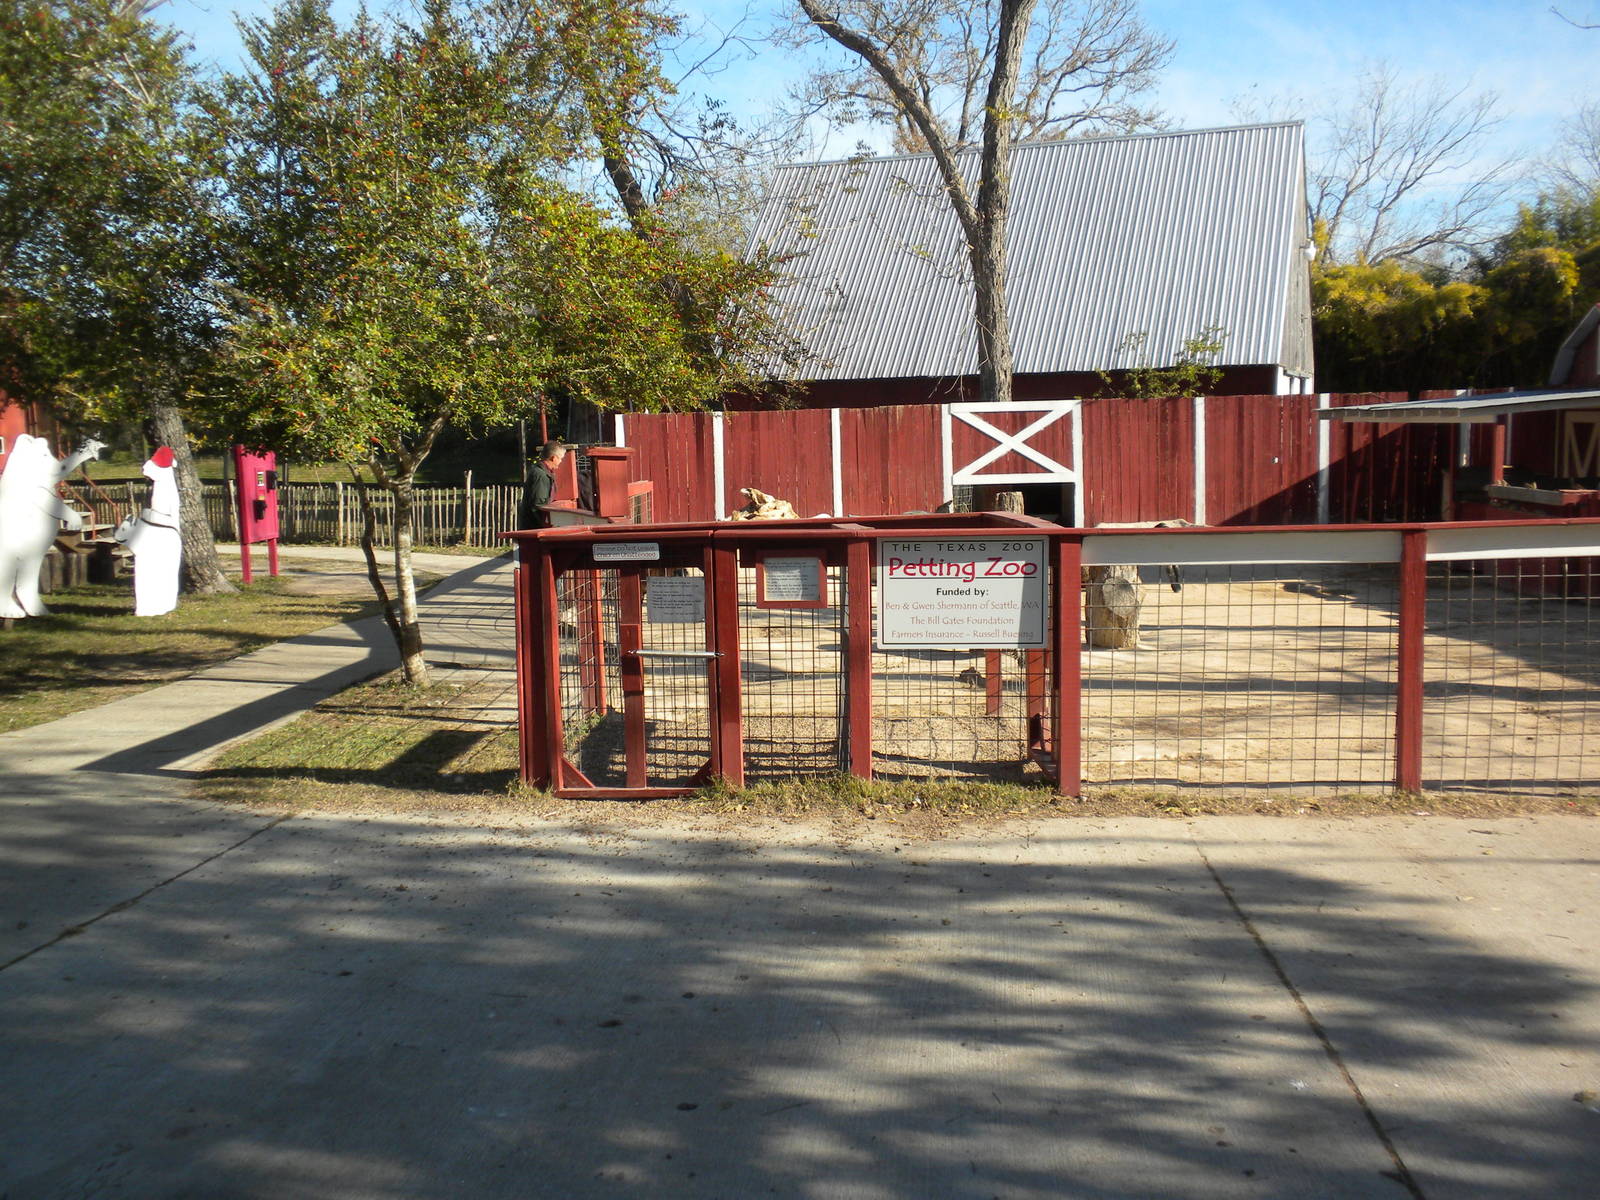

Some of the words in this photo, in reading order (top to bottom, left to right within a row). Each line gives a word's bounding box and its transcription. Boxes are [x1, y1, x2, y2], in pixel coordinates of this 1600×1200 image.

[892, 543, 921, 552] THE
[937, 543, 986, 552] TEXAS
[1002, 542, 1034, 552] ZOO
[889, 557, 976, 583] Petting
[984, 556, 1038, 576] Zoo
[936, 587, 971, 596] Funded
[974, 587, 989, 597] by:
[885, 601, 900, 610] Ben
[902, 601, 910, 610] &
[912, 601, 934, 610] Gwen
[937, 600, 977, 610] Shermann
[980, 600, 991, 610] of
[1022, 601, 1040, 609] WA
[910, 616, 925, 625] The
[927, 615, 940, 625] Bill
[942, 616, 964, 625] Gates
[966, 616, 1014, 625] Foundation
[891, 630, 923, 638] Farmers
[925, 630, 965, 639] Insurance
[973, 629, 1000, 638] Russell
